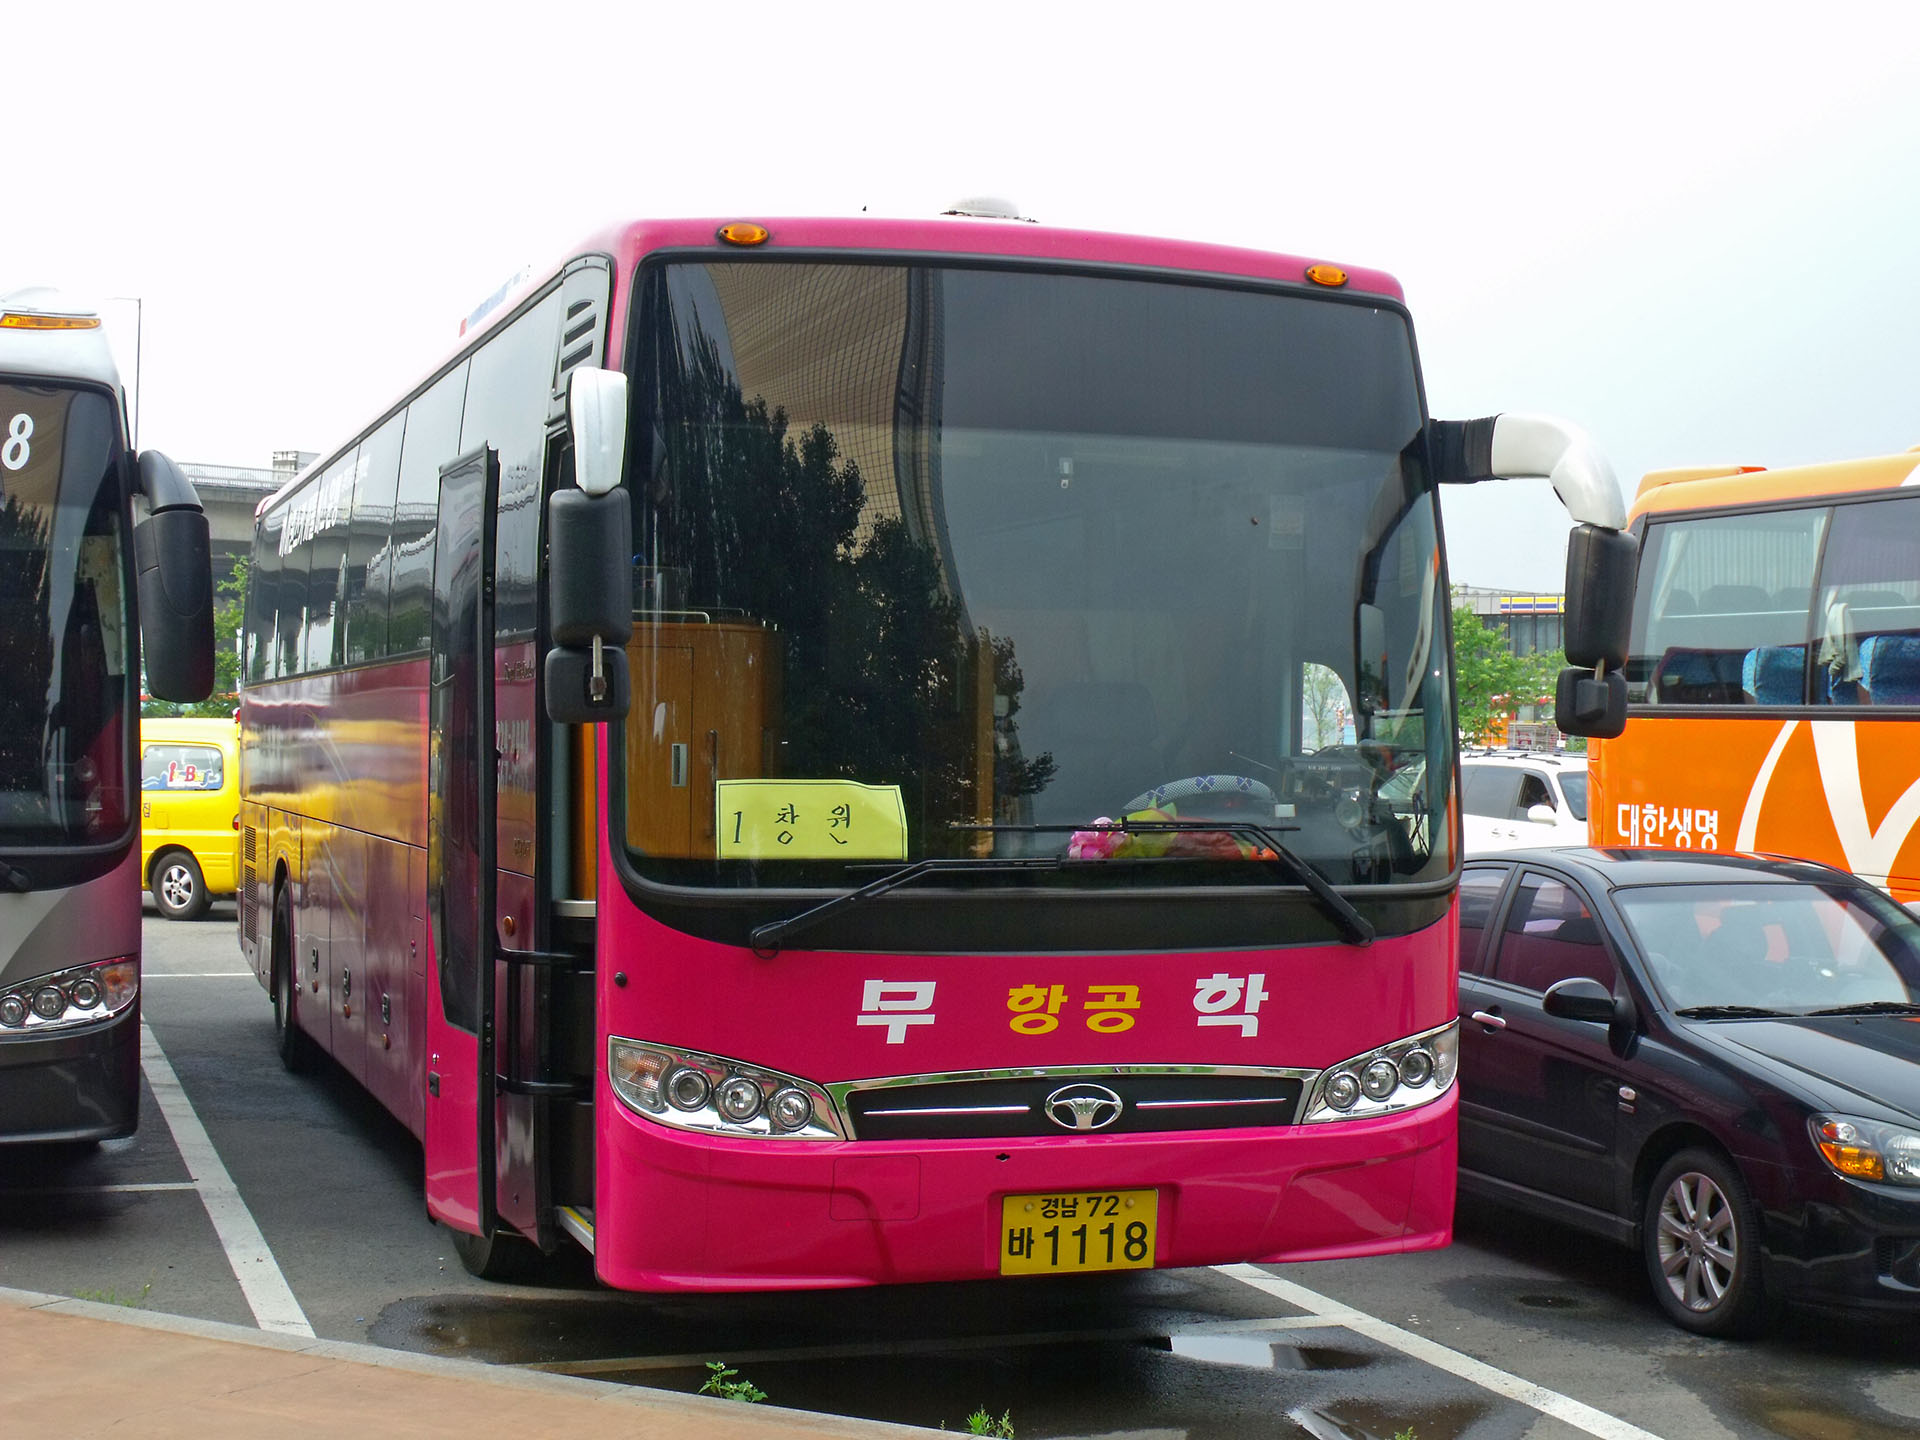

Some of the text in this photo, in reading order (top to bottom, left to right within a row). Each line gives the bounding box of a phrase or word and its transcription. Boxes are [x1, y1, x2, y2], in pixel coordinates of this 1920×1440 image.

[1, 413, 34, 470] 8
[733, 811, 743, 844] 1
[1617, 803, 1718, 850] 대한생명
[857, 973, 1269, 1044] 무 항공 학
[1041, 1195, 1120, 1218] 경남 72
